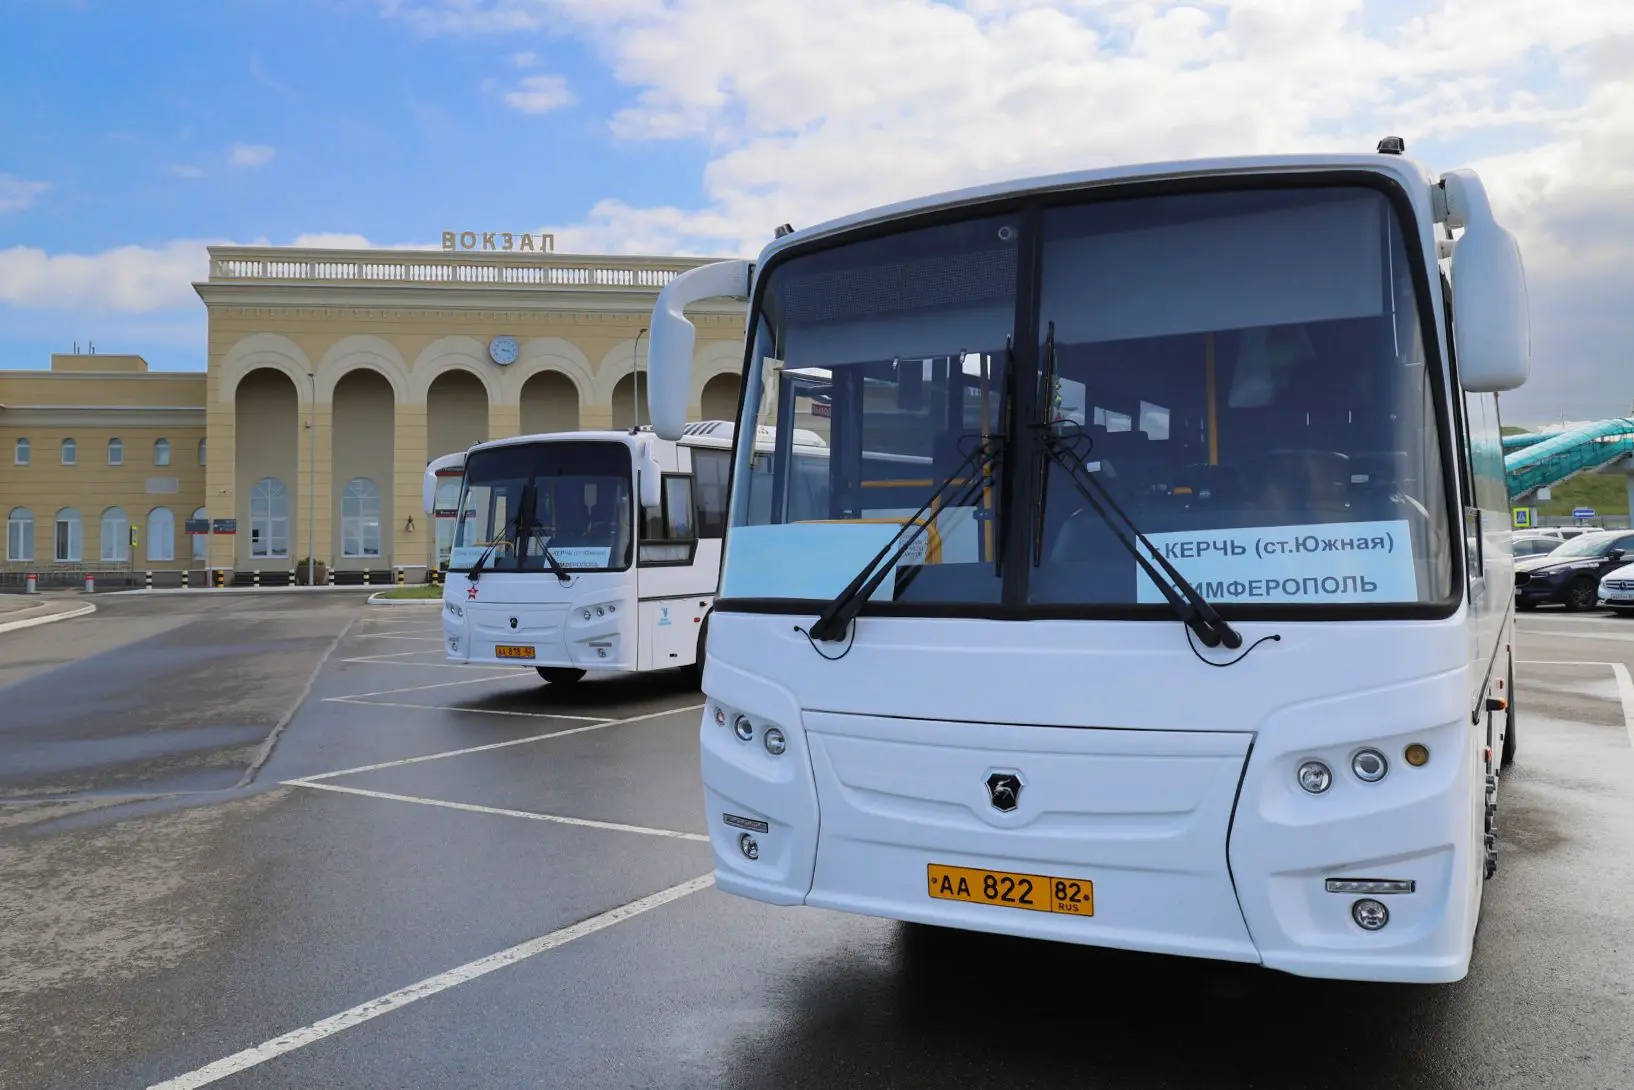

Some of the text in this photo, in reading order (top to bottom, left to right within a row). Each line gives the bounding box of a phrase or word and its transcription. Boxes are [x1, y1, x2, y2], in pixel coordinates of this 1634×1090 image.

[442, 231, 554, 253] ВОКЗАЛ
[1255, 531, 1394, 559] (ст.Южная)
[1172, 575, 1378, 599] ИМФЕРОПОЛЬ
[940, 874, 1082, 905] АА 822 82
[1058, 903, 1079, 912] RUS
